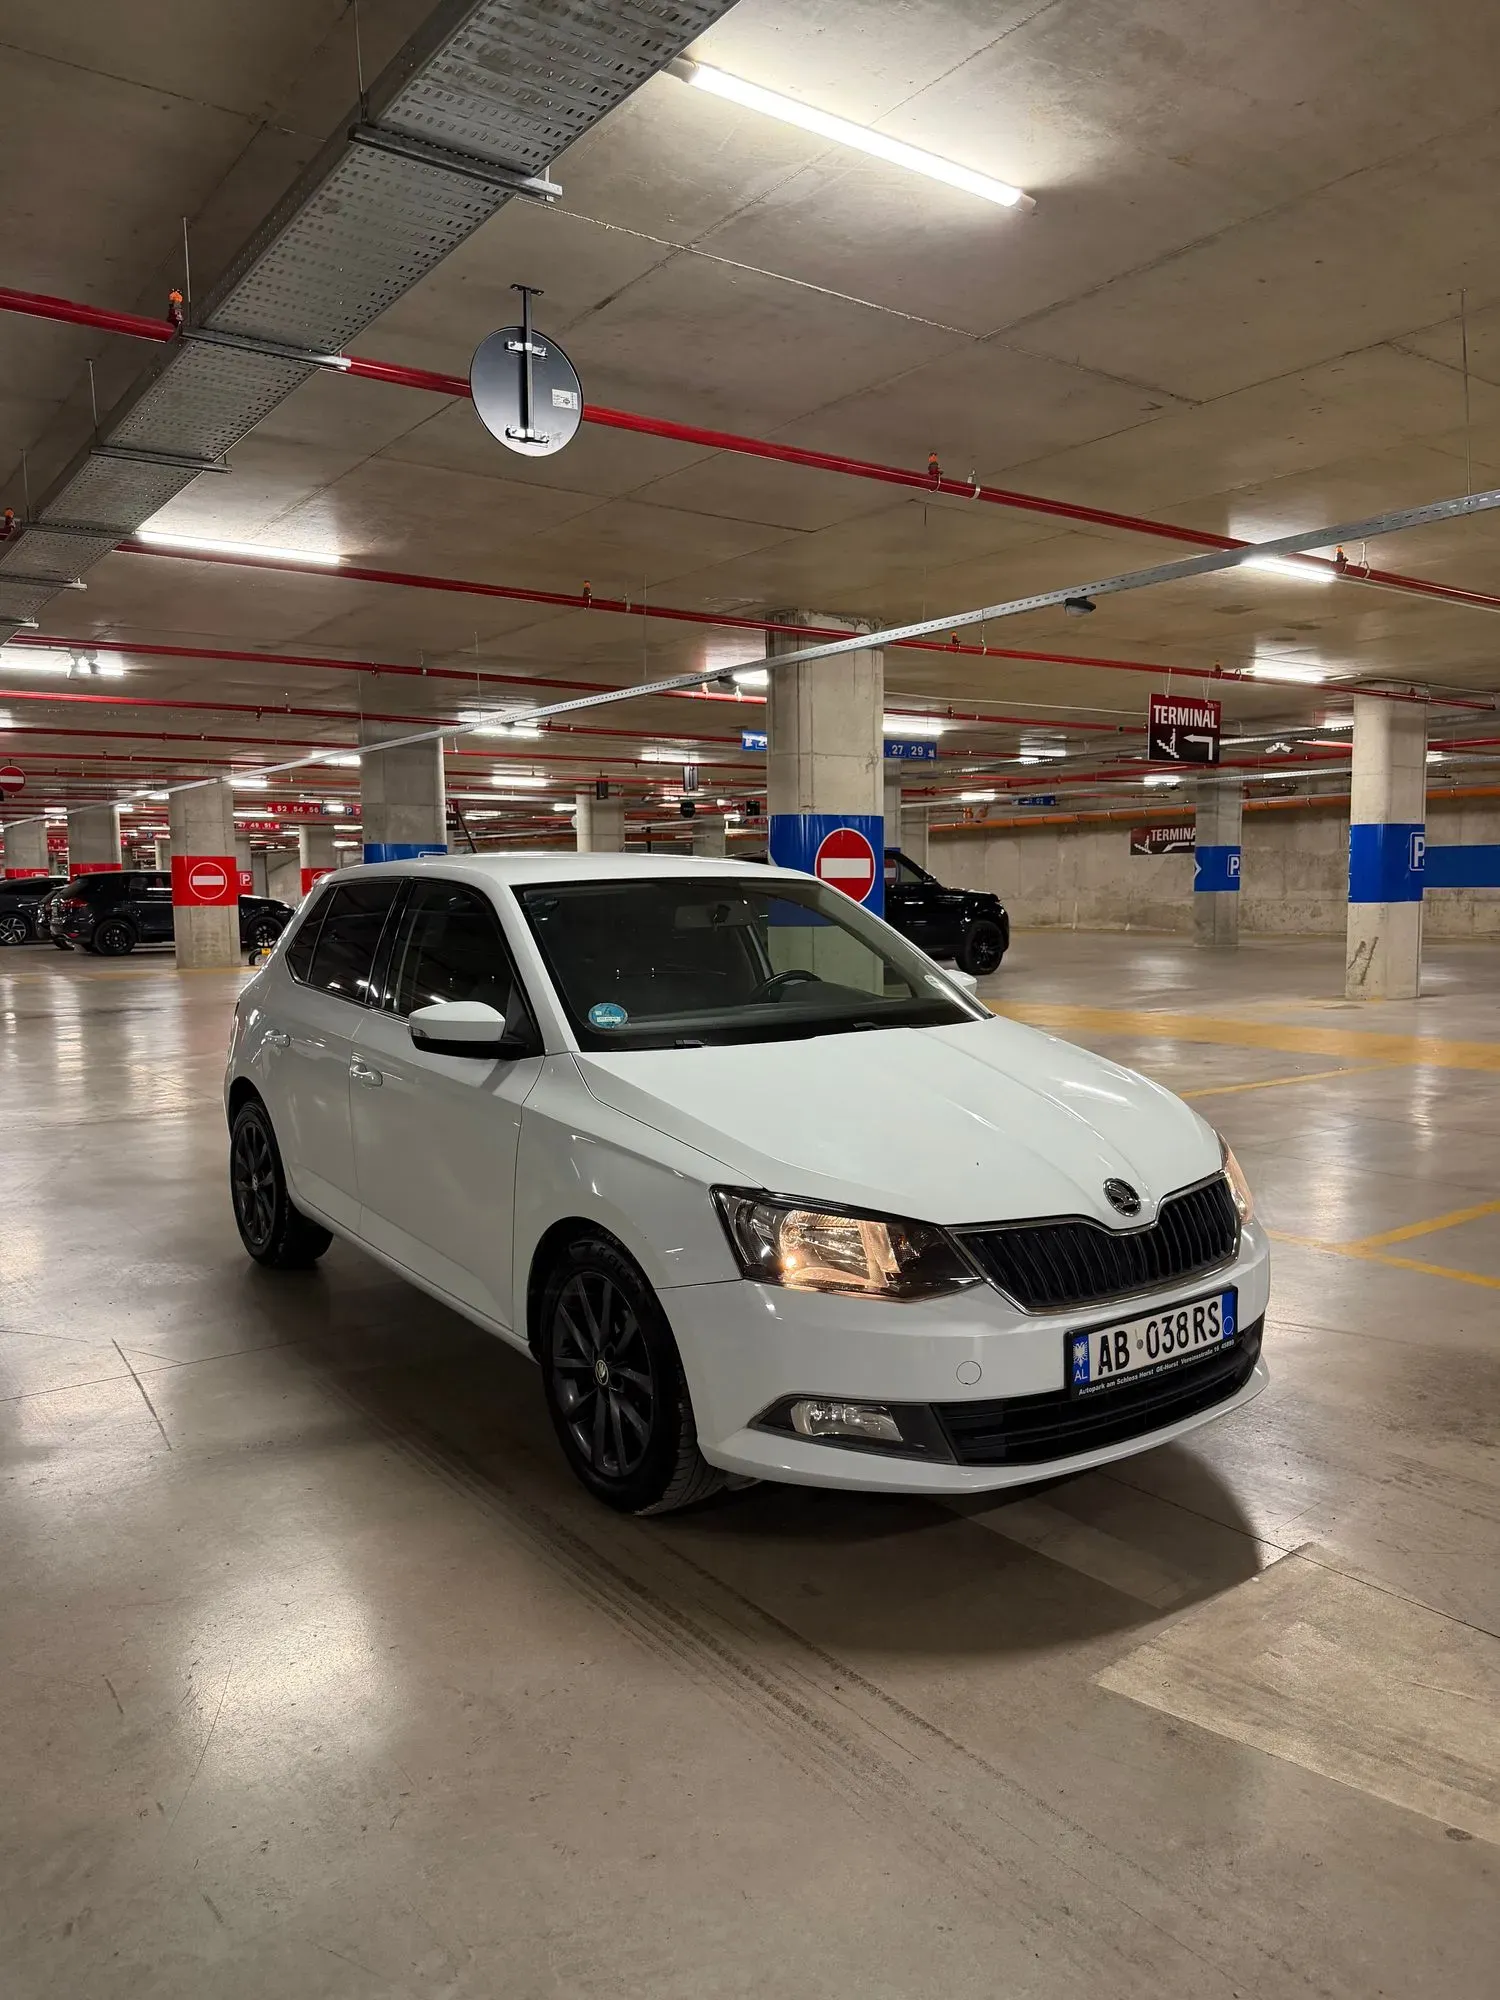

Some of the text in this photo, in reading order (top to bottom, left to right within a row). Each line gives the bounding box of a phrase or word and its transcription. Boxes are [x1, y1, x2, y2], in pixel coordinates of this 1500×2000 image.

[1153, 705, 1218, 728] TERMINAL
[891, 745, 924, 756] 27 29
[1151, 827, 1196, 841] TERMINA
[242, 874, 251, 885] P
[1098, 1331, 1130, 1376] AB
[1074, 1369, 1088, 1382] AL
[1079, 1383, 1105, 1396] Autopark
[1116, 1374, 1138, 1386] Schloss
[1139, 1369, 1154, 1379] Horst
